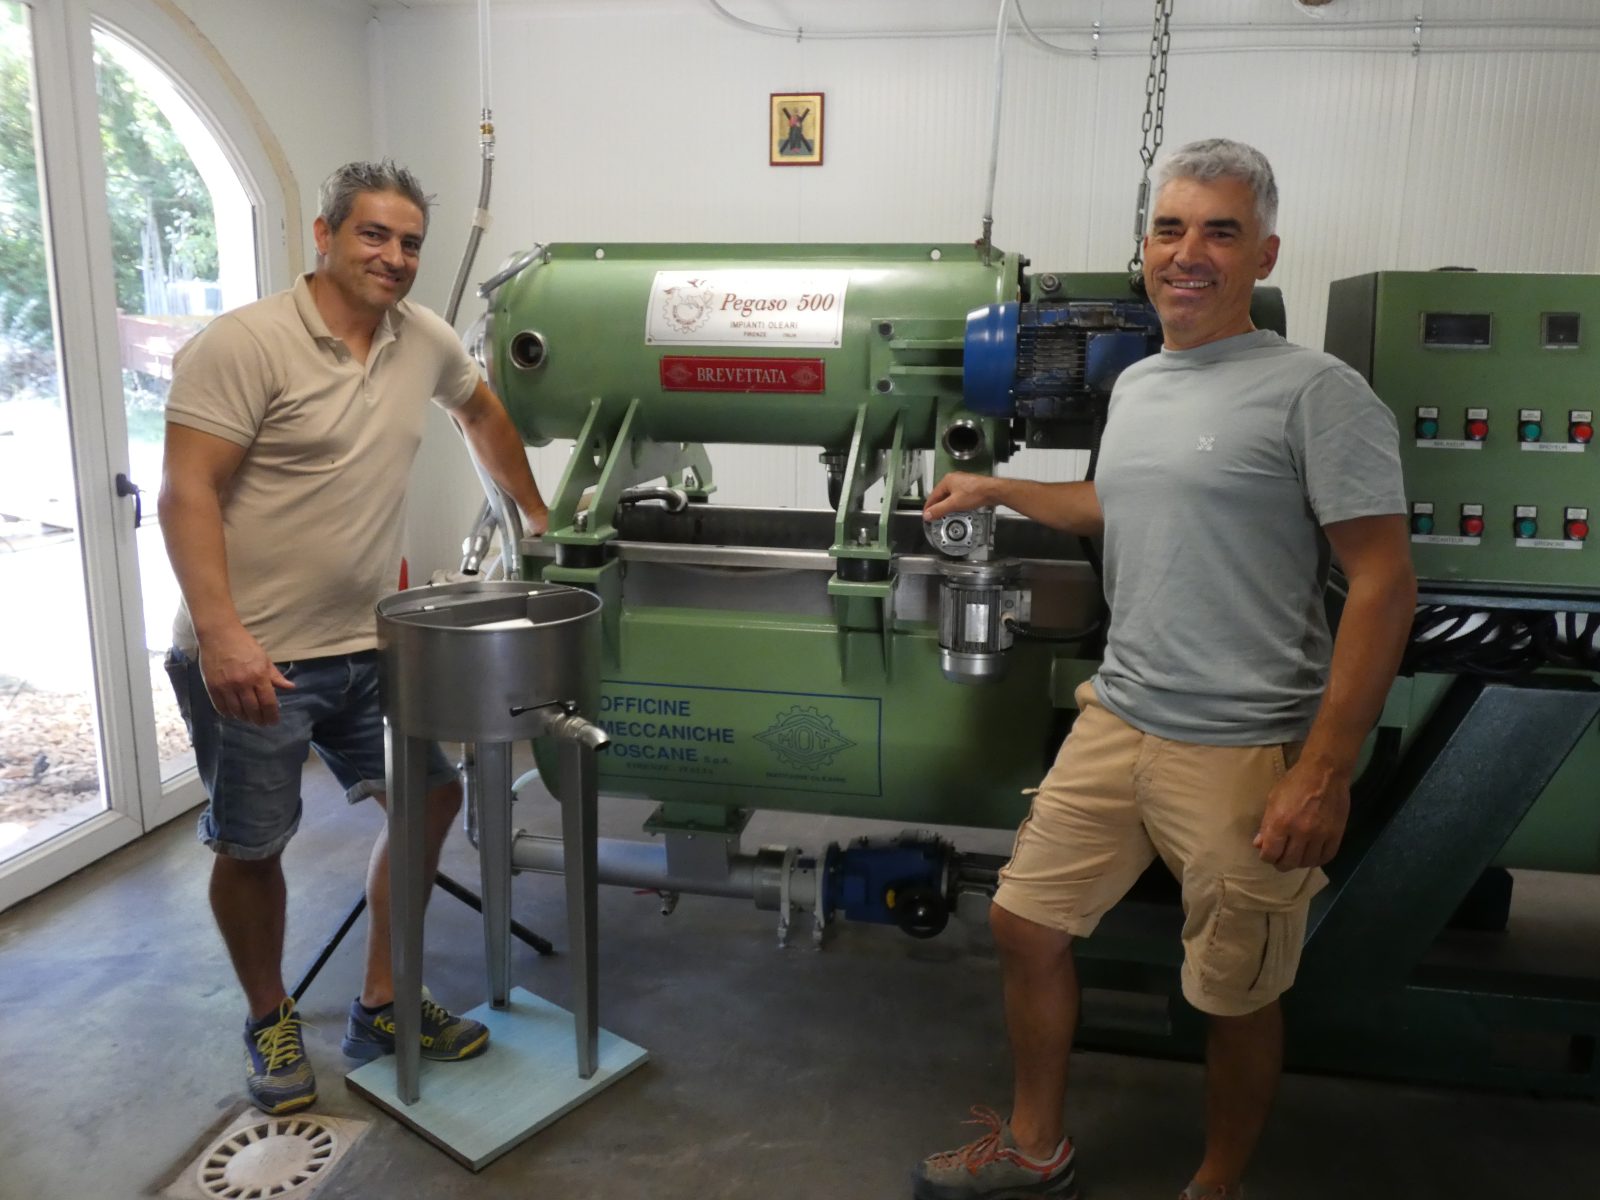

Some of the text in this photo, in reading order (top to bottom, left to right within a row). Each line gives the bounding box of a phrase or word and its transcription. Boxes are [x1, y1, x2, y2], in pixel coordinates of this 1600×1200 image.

[720, 292, 788, 317] Pegaso
[796, 293, 835, 311] 500
[730, 321, 798, 329] IMPIANTI OLEARI
[697, 367, 787, 384] BREVETTATA
[600, 695, 691, 717] OFFICINE
[599, 720, 735, 744] MECCANICHE
